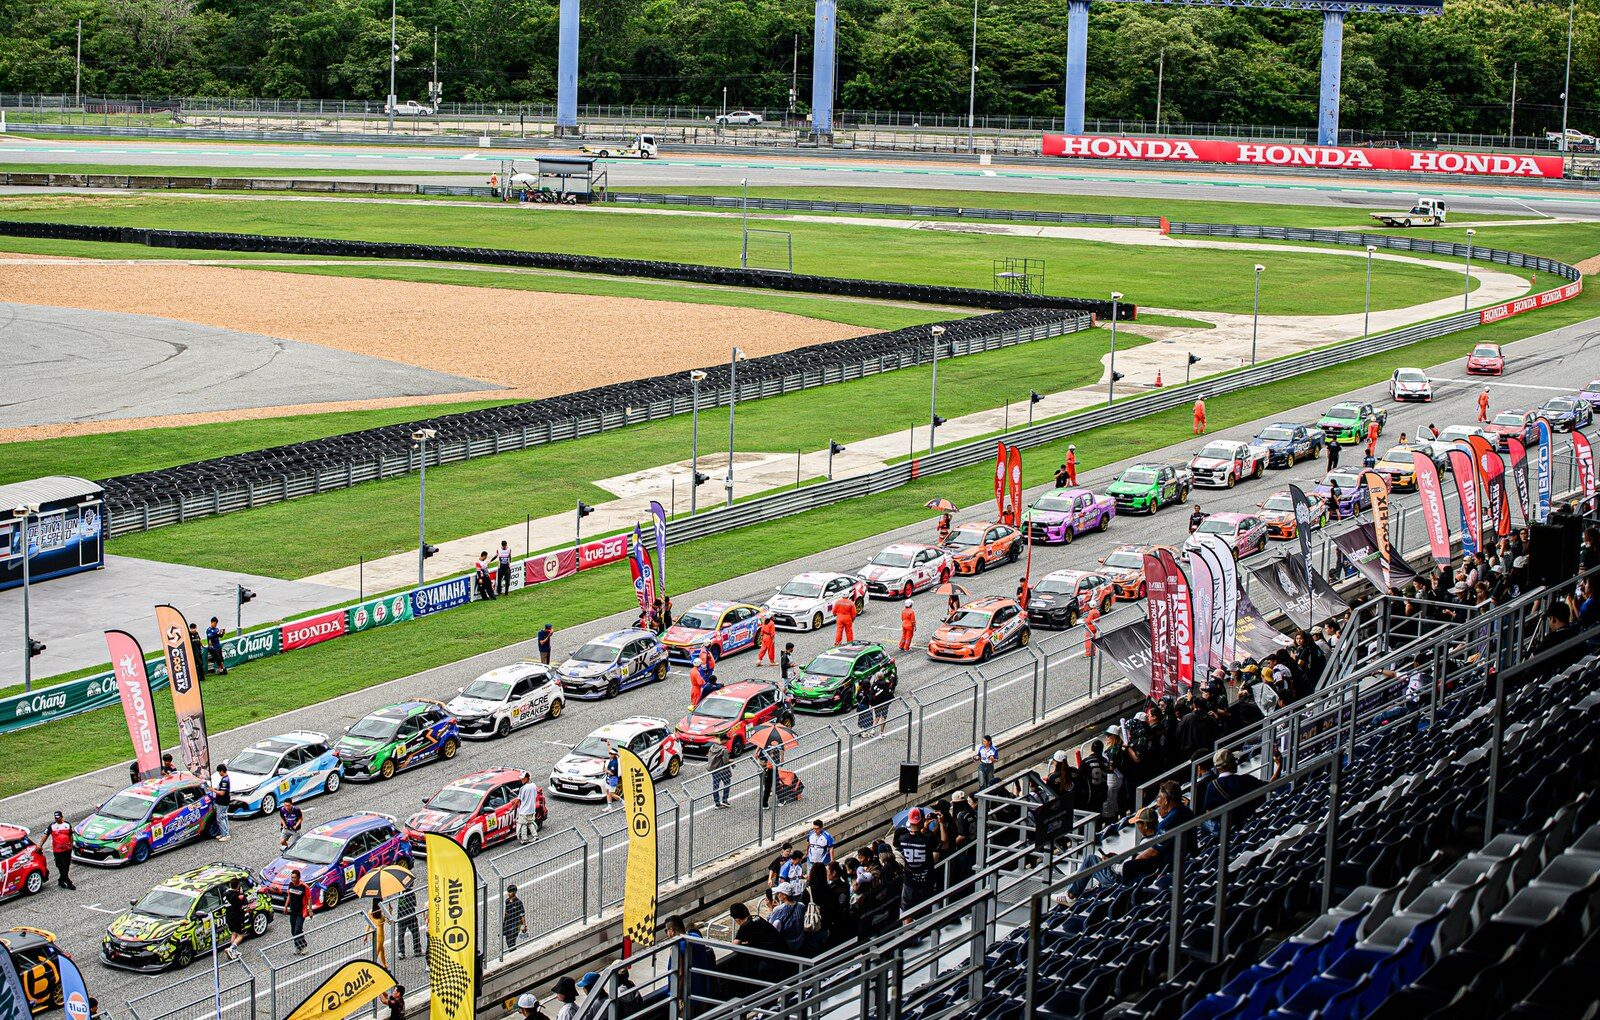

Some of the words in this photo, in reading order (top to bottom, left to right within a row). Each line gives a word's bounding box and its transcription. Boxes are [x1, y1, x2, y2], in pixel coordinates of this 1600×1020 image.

[1062, 137, 1199, 159] HONDA
[1236, 144, 1372, 168] HONDA
[1410, 152, 1543, 175] HONDA
[1513, 297, 1537, 312] HONDA
[1541, 289, 1563, 305] HONDA
[1483, 305, 1508, 321] HONDA
[28, 518, 79, 538] DESTINAION
[545, 560, 557, 572] CP
[427, 580, 467, 605] YAMAHA
[420, 598, 464, 614] RACING
[287, 620, 342, 644] HONDA
[237, 633, 273, 655] Chang
[630, 652, 649, 676] JK
[31, 692, 67, 711] Chang
[528, 694, 549, 708] ACRE
[520, 703, 550, 720] BRAKES
[488, 818, 496, 828] 36
[903, 848, 926, 862] 95
[346, 871, 354, 880] 53
[327, 968, 372, 1010] B-Quik
